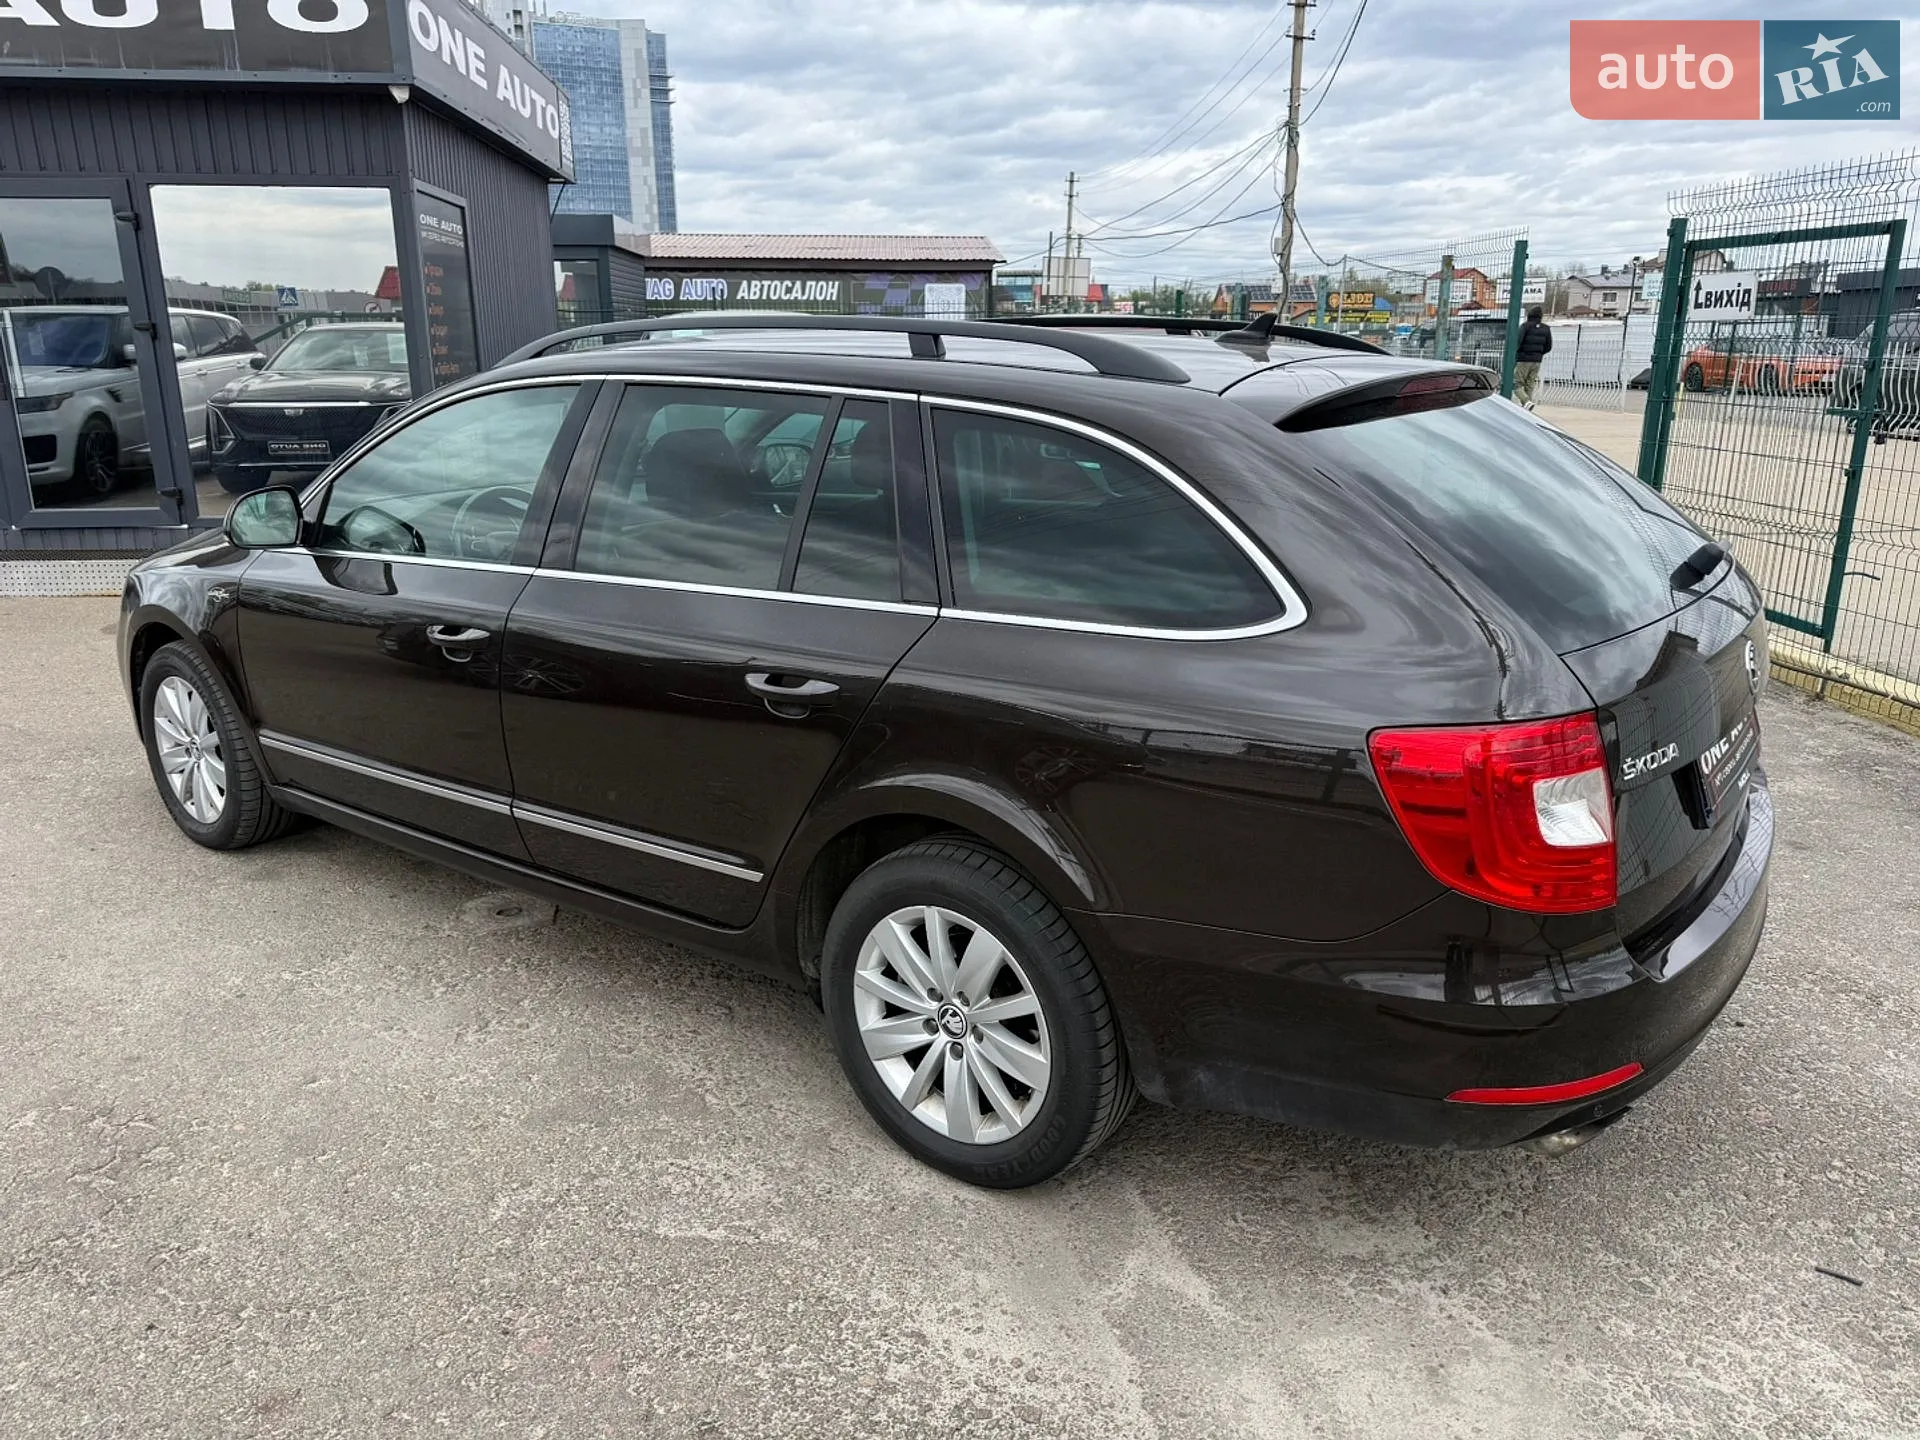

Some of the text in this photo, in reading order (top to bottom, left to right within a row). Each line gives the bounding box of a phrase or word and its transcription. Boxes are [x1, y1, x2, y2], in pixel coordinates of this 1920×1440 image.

[408, 0, 560, 139] ONE AUTO
[420, 213, 463, 235] ONE AUTO
[680, 278, 728, 301] AUTO
[736, 279, 840, 301] АВТОСАЛОН
[1622, 742, 1680, 781] ŠKODA
[1700, 737, 1730, 775] ONE
